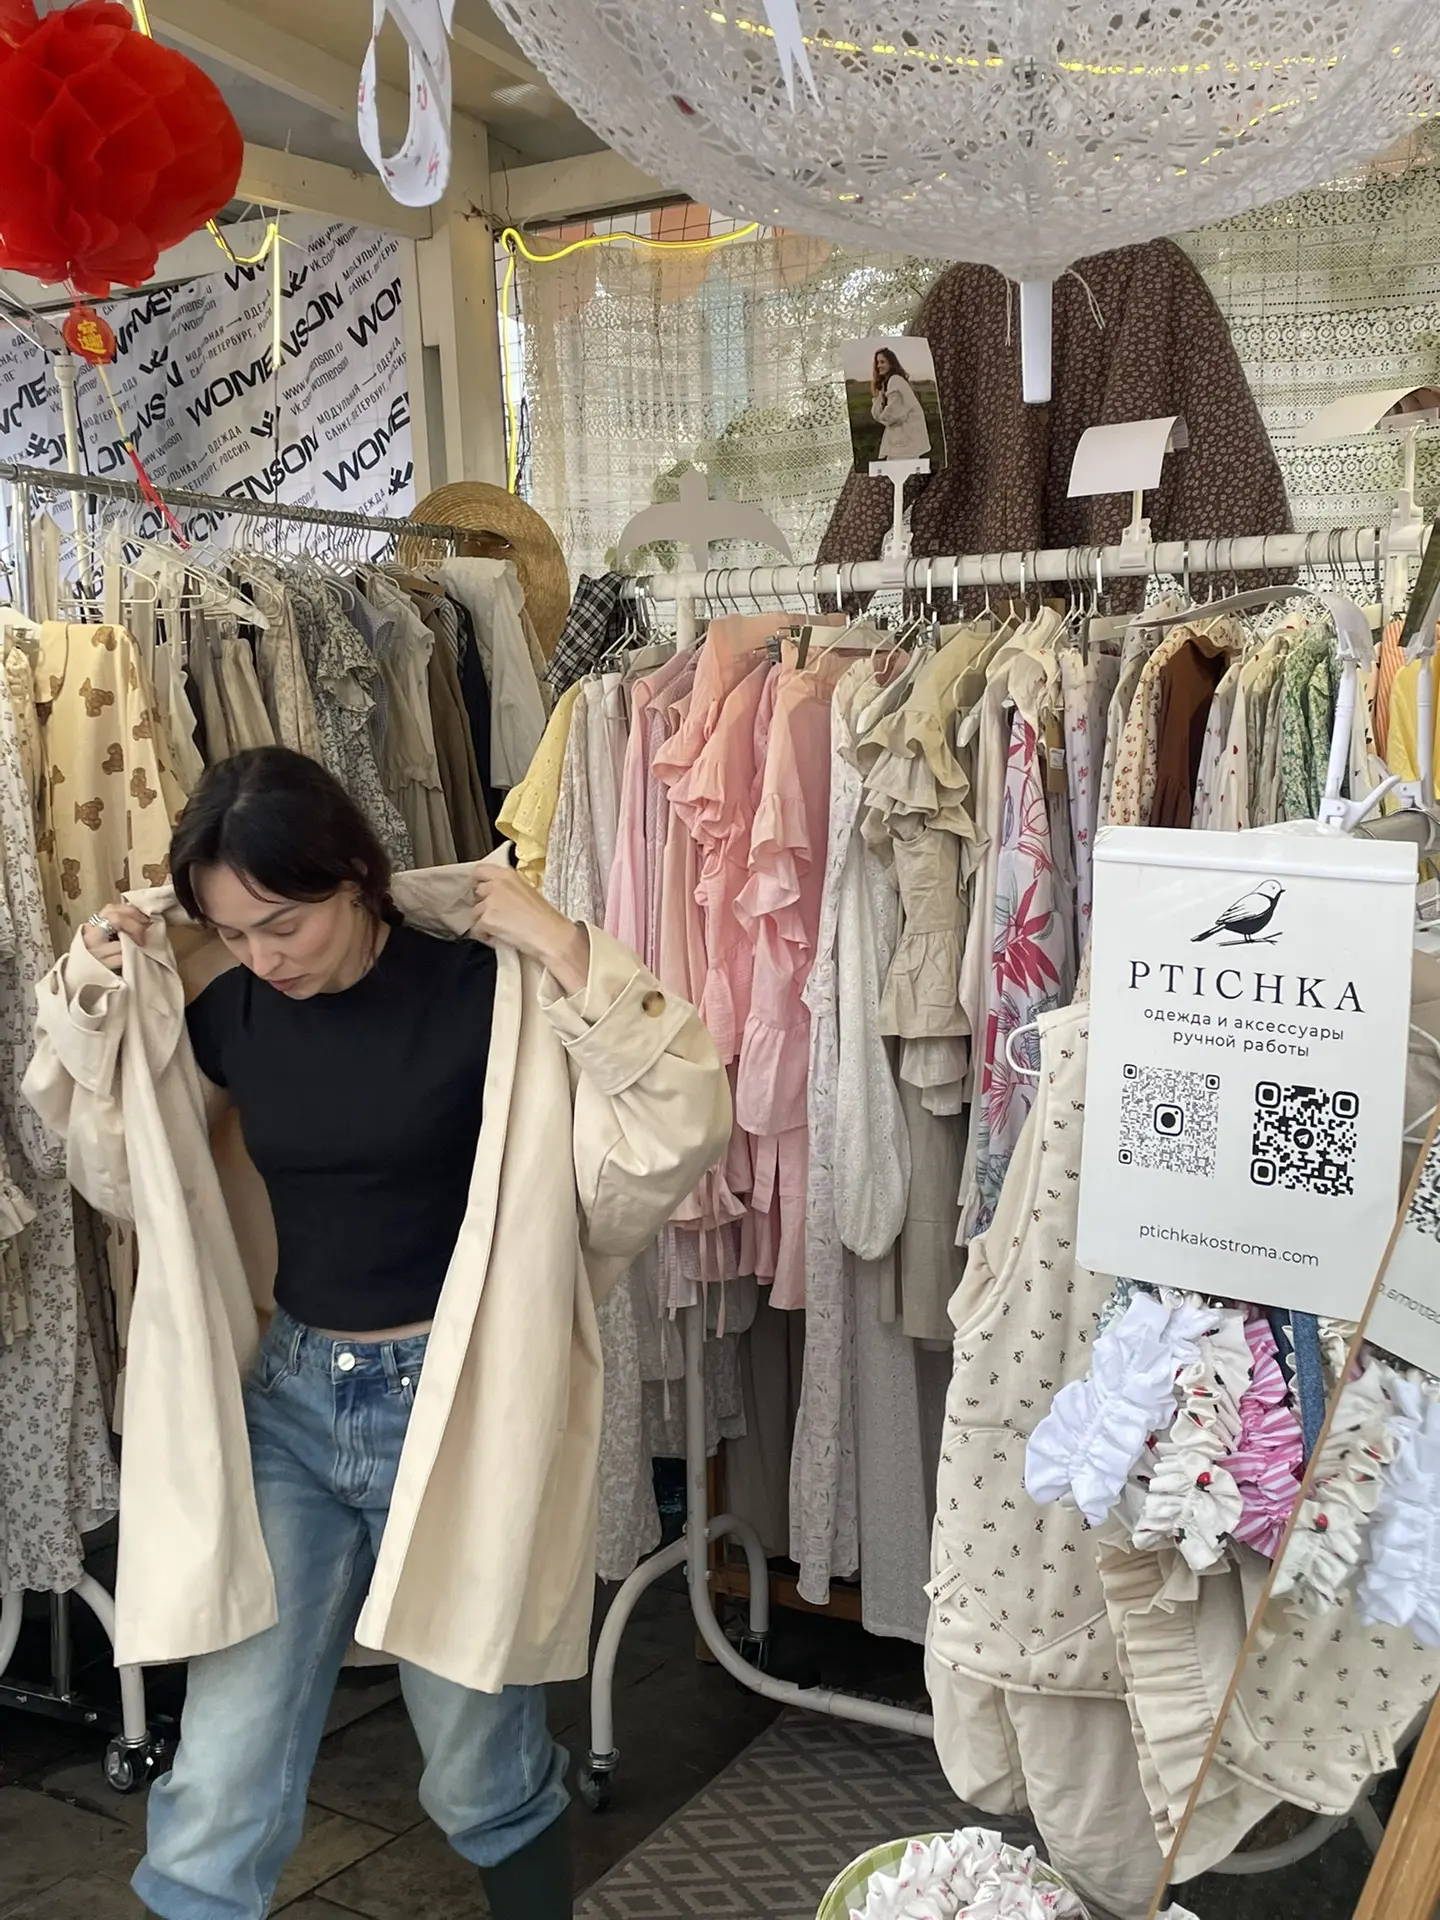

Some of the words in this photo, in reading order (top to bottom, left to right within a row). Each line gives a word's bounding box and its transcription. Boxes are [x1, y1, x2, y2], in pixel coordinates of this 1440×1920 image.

[207, 425, 243, 454] ОДЕЖДА
[219, 440, 251, 466] РОССИЯ
[322, 391, 411, 494] WOME
[1128, 960, 1366, 1014] PTICHKA
[1144, 1008, 1211, 1027] одежда
[1218, 1017, 1228, 1028] и
[1234, 1017, 1344, 1041] аксессуары
[1173, 1030, 1236, 1049] ручной
[1243, 1039, 1310, 1057] работы
[1139, 1225, 1320, 1267] ptichkakostroma.com
